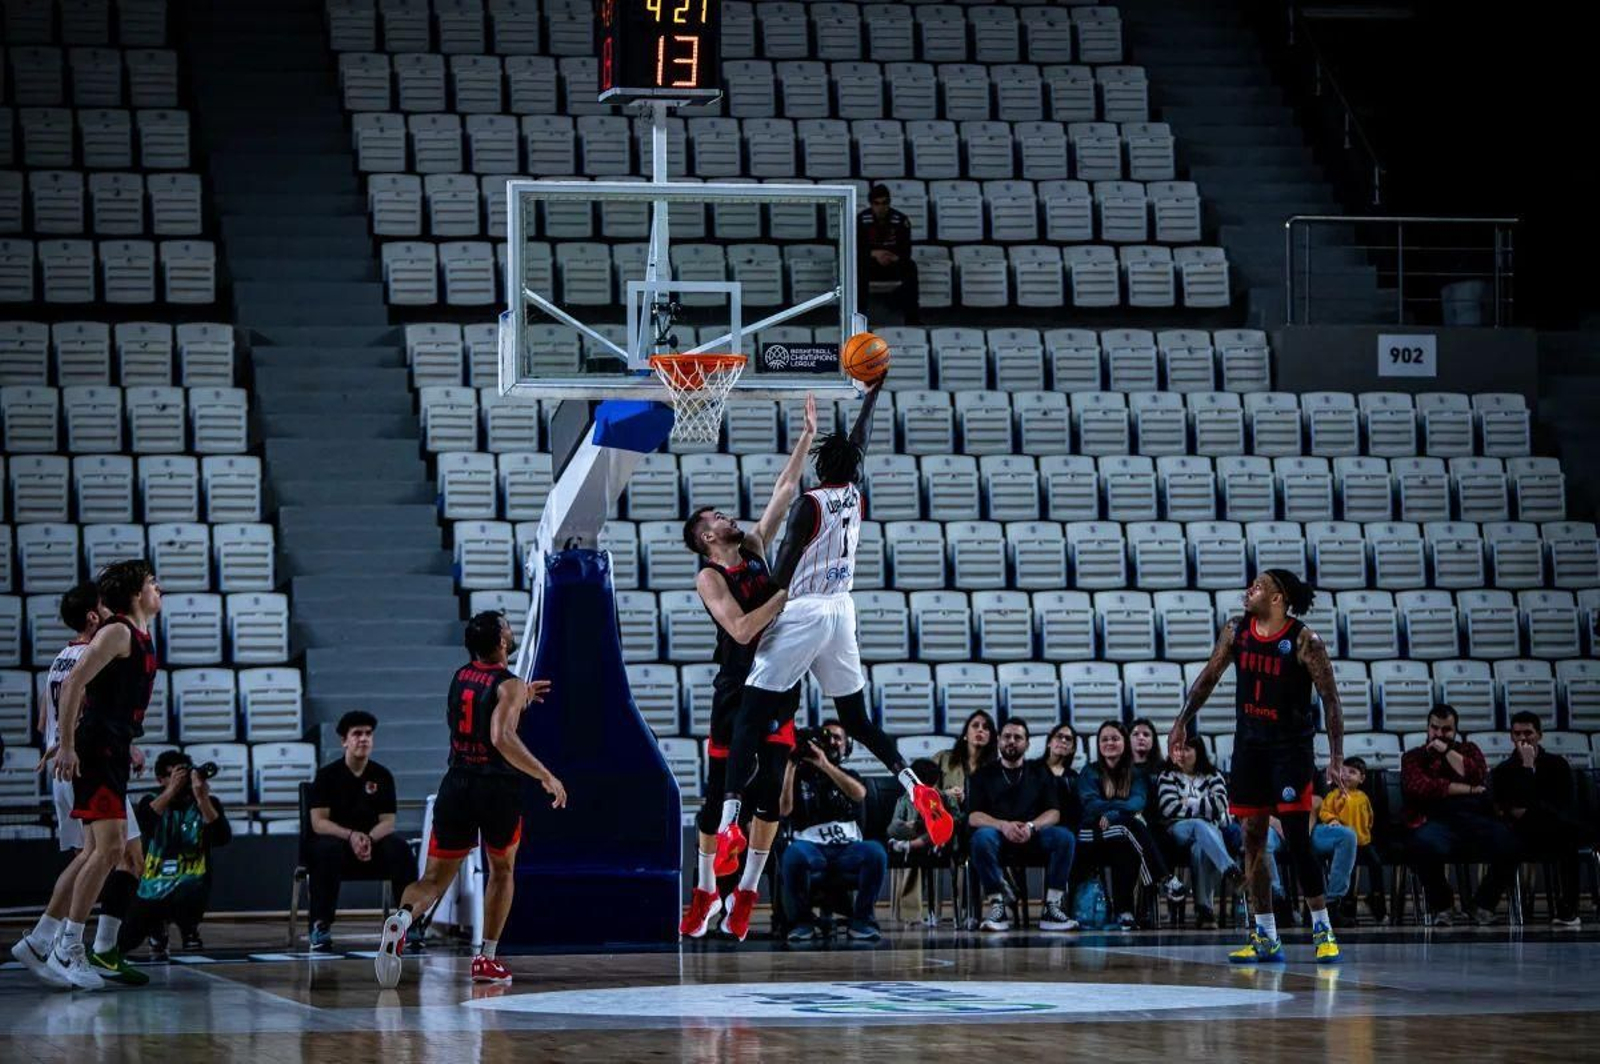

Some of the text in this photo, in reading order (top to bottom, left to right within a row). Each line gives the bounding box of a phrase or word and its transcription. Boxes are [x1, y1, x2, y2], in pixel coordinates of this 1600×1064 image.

[656, 35, 699, 87] 13
[789, 354, 838, 362] CHAMPIONS
[789, 360, 817, 368] LEAGUE
[1390, 347, 1424, 364] 902
[841, 517, 850, 558] 7
[459, 689, 475, 734] 3
